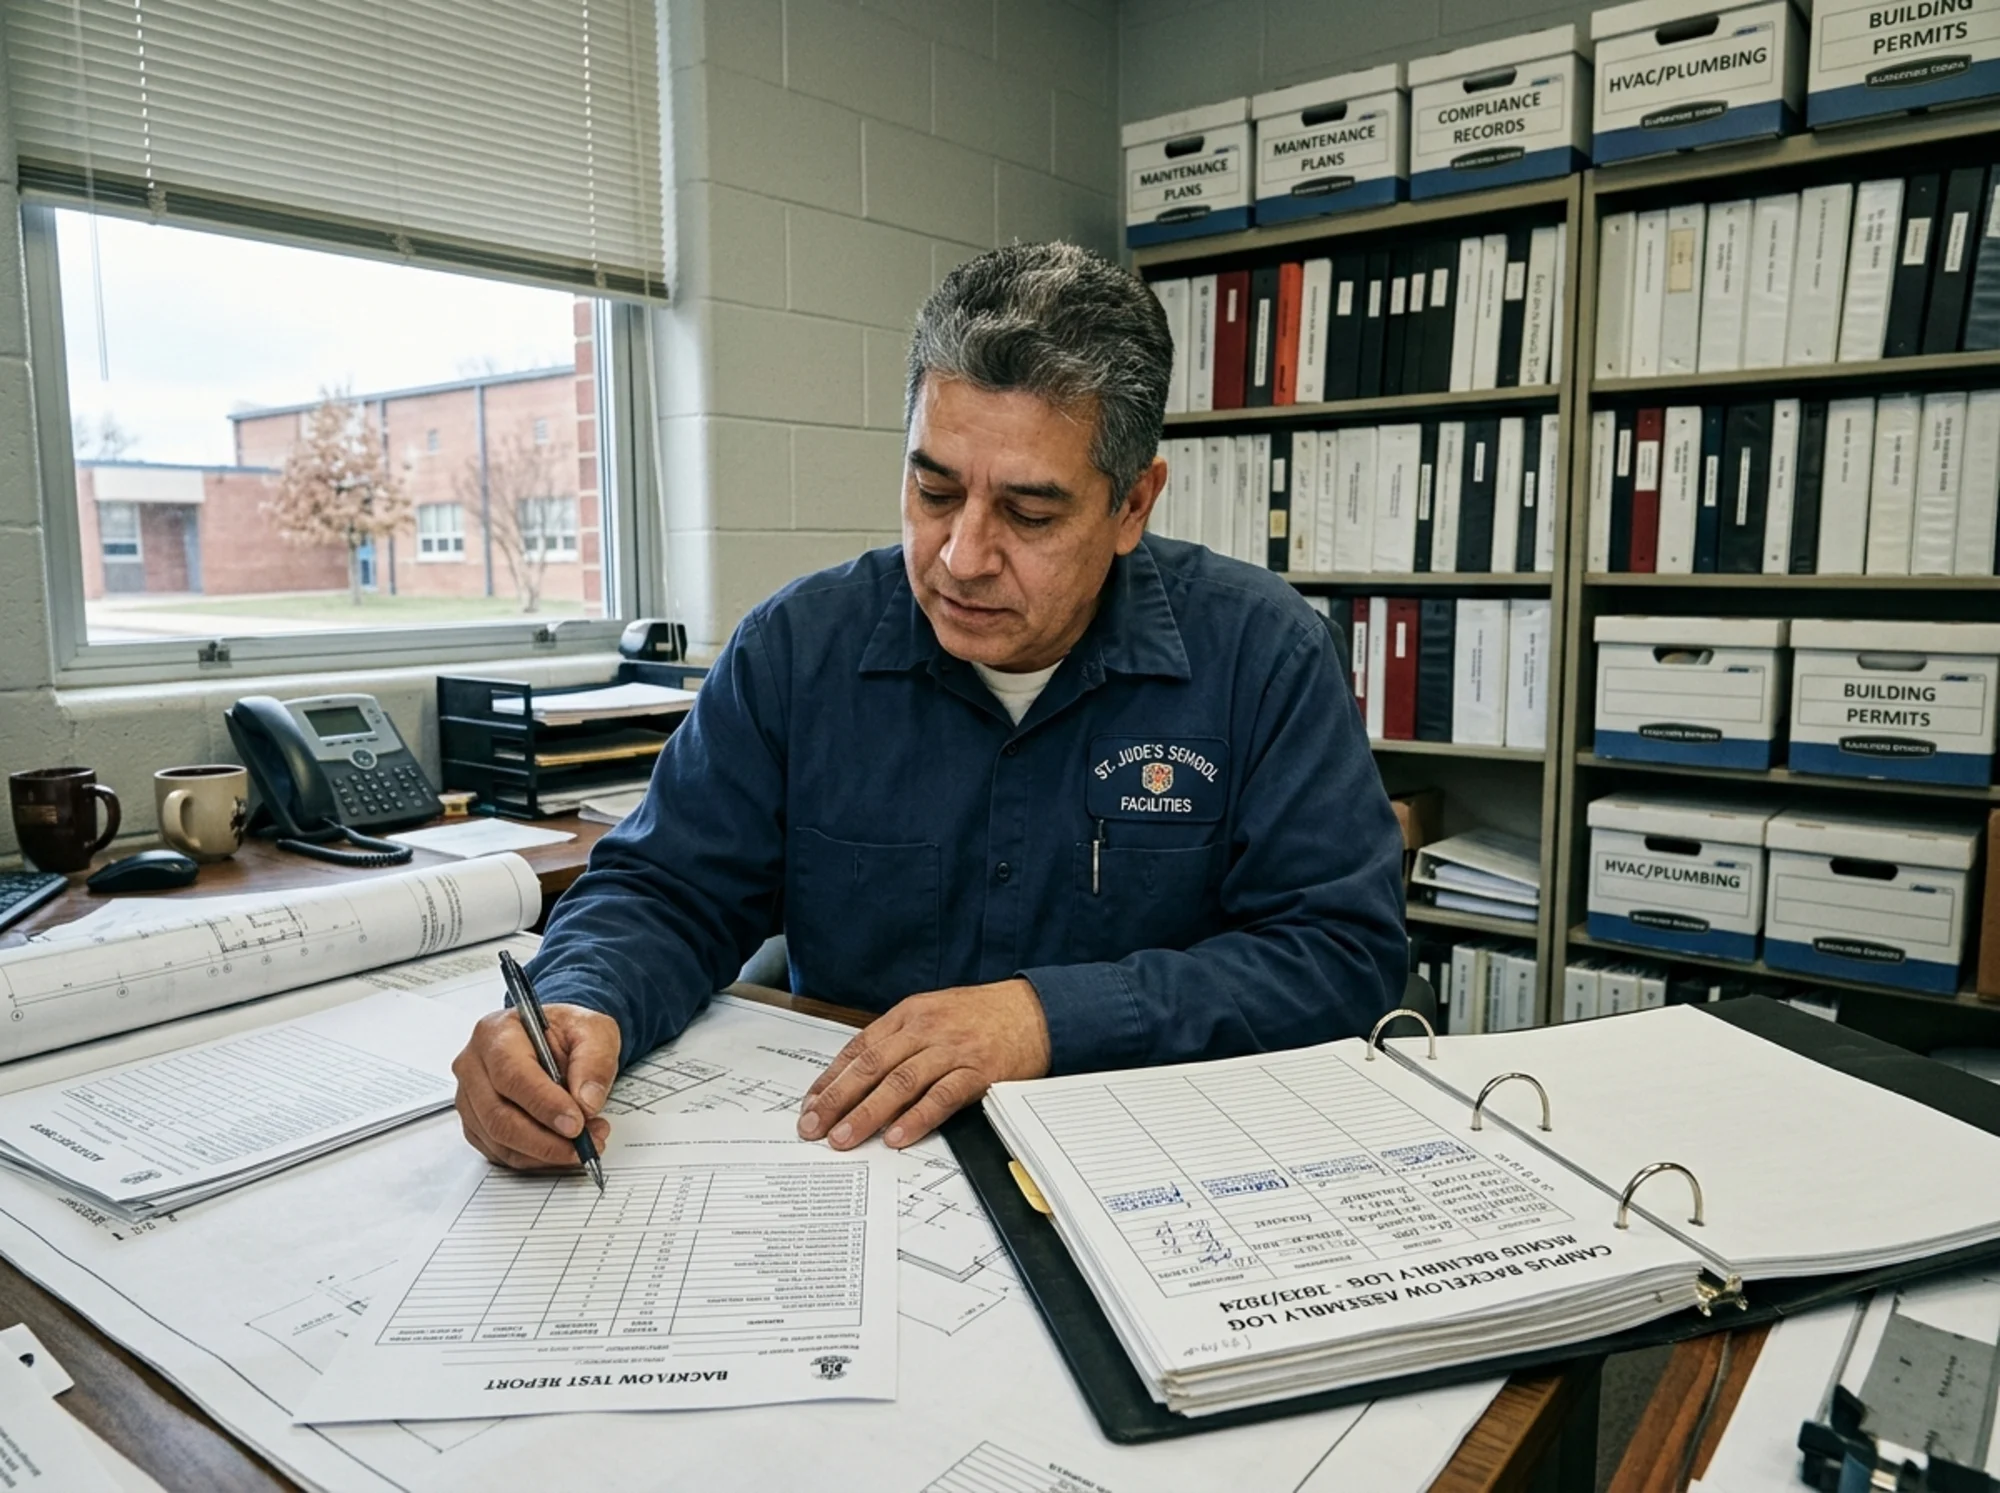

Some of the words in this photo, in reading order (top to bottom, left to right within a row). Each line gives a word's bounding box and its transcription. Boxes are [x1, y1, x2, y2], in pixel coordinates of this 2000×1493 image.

[1869, 0, 1973, 29] BUILDING
[1873, 21, 1968, 55] PERMITS
[1609, 47, 1767, 93] HVAC/PLUMBING
[1273, 125, 1376, 156] MAINTENANCE
[1453, 118, 1526, 145] RECORDS
[1140, 158, 1229, 186] MAINTENANCE
[1301, 152, 1346, 172] PLANS
[1164, 183, 1203, 201] PLANS
[1843, 682, 1937, 702] BUILDING
[1846, 708, 1931, 727] PERMITS
[1094, 759, 1116, 780] ST.
[1117, 744, 1164, 768] JUDE'S
[1120, 796, 1192, 813] FACILITIES
[1604, 859, 1741, 889] HVAC/PLUMBING
[1227, 1314, 1278, 1331] LOG
